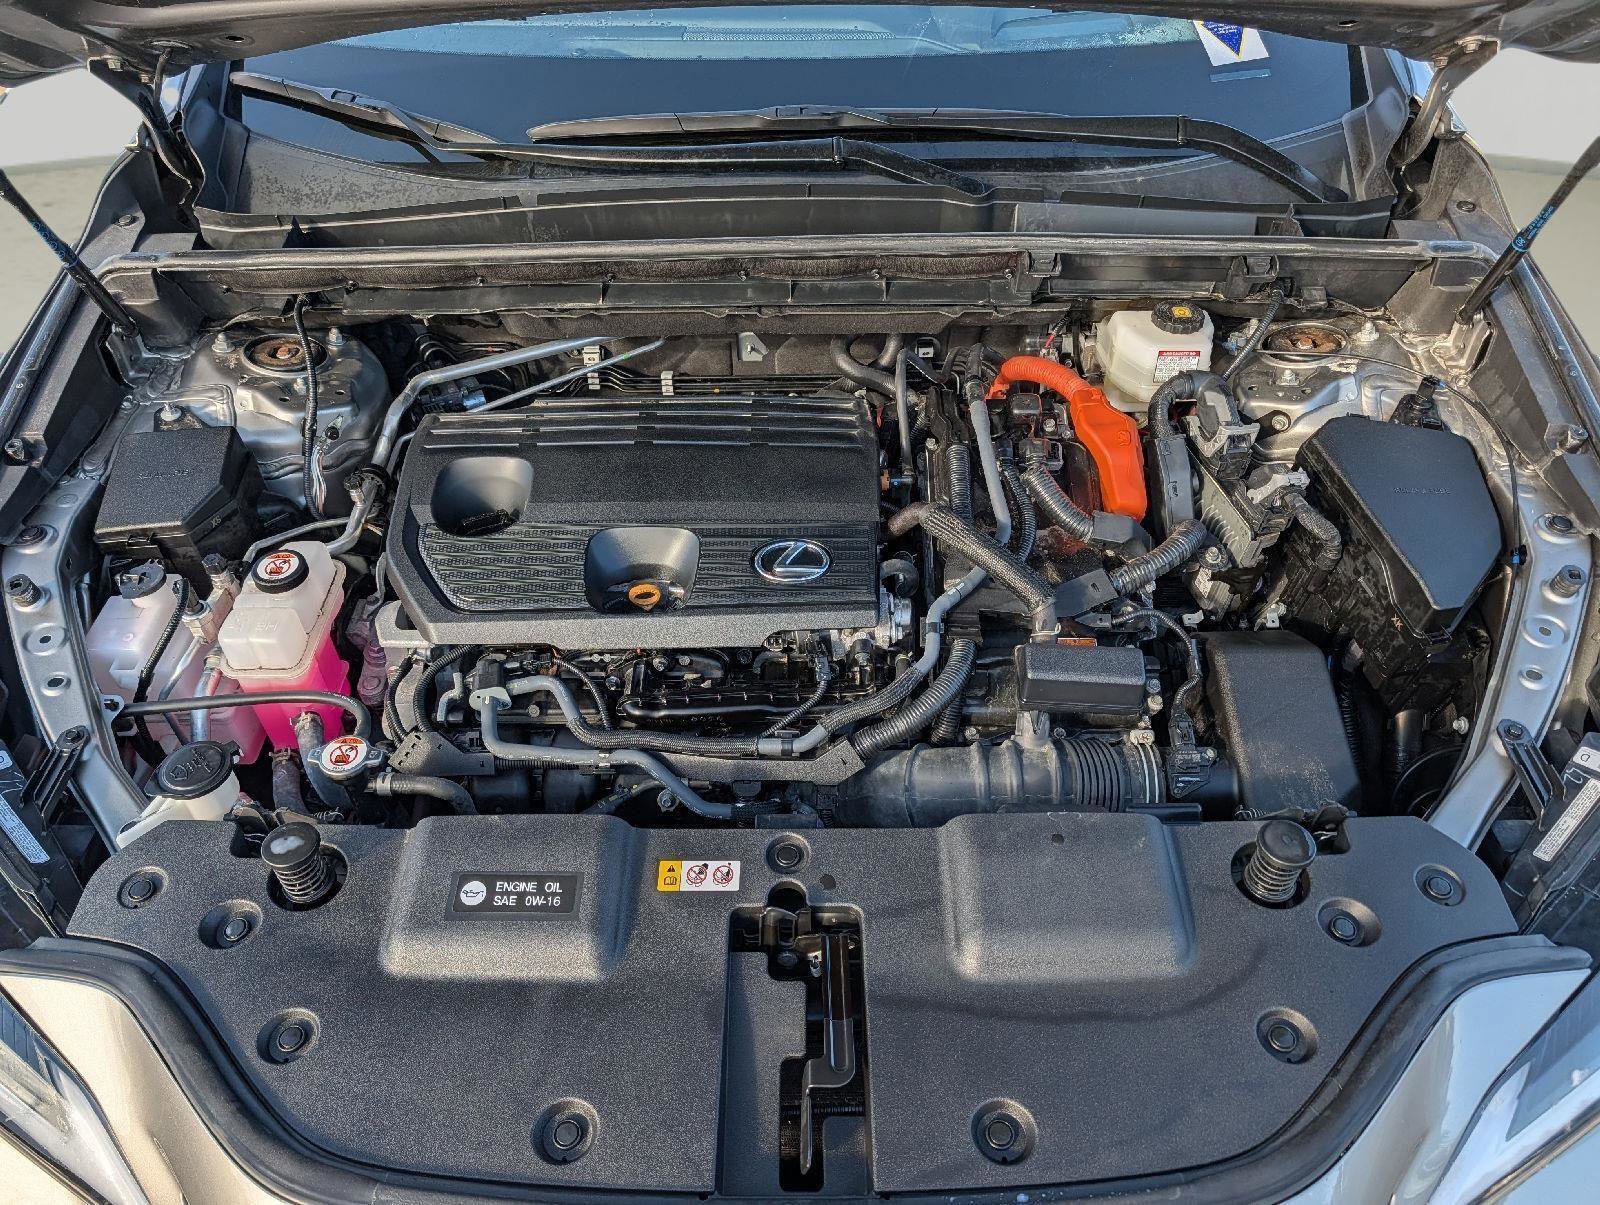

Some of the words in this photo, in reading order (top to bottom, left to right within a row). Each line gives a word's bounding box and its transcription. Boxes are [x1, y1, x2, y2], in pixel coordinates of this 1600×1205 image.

[495, 881, 538, 892] ENGINE
[544, 882, 563, 893] OIL
[493, 895, 518, 906] SAE
[525, 895, 561, 907] 0W-16
